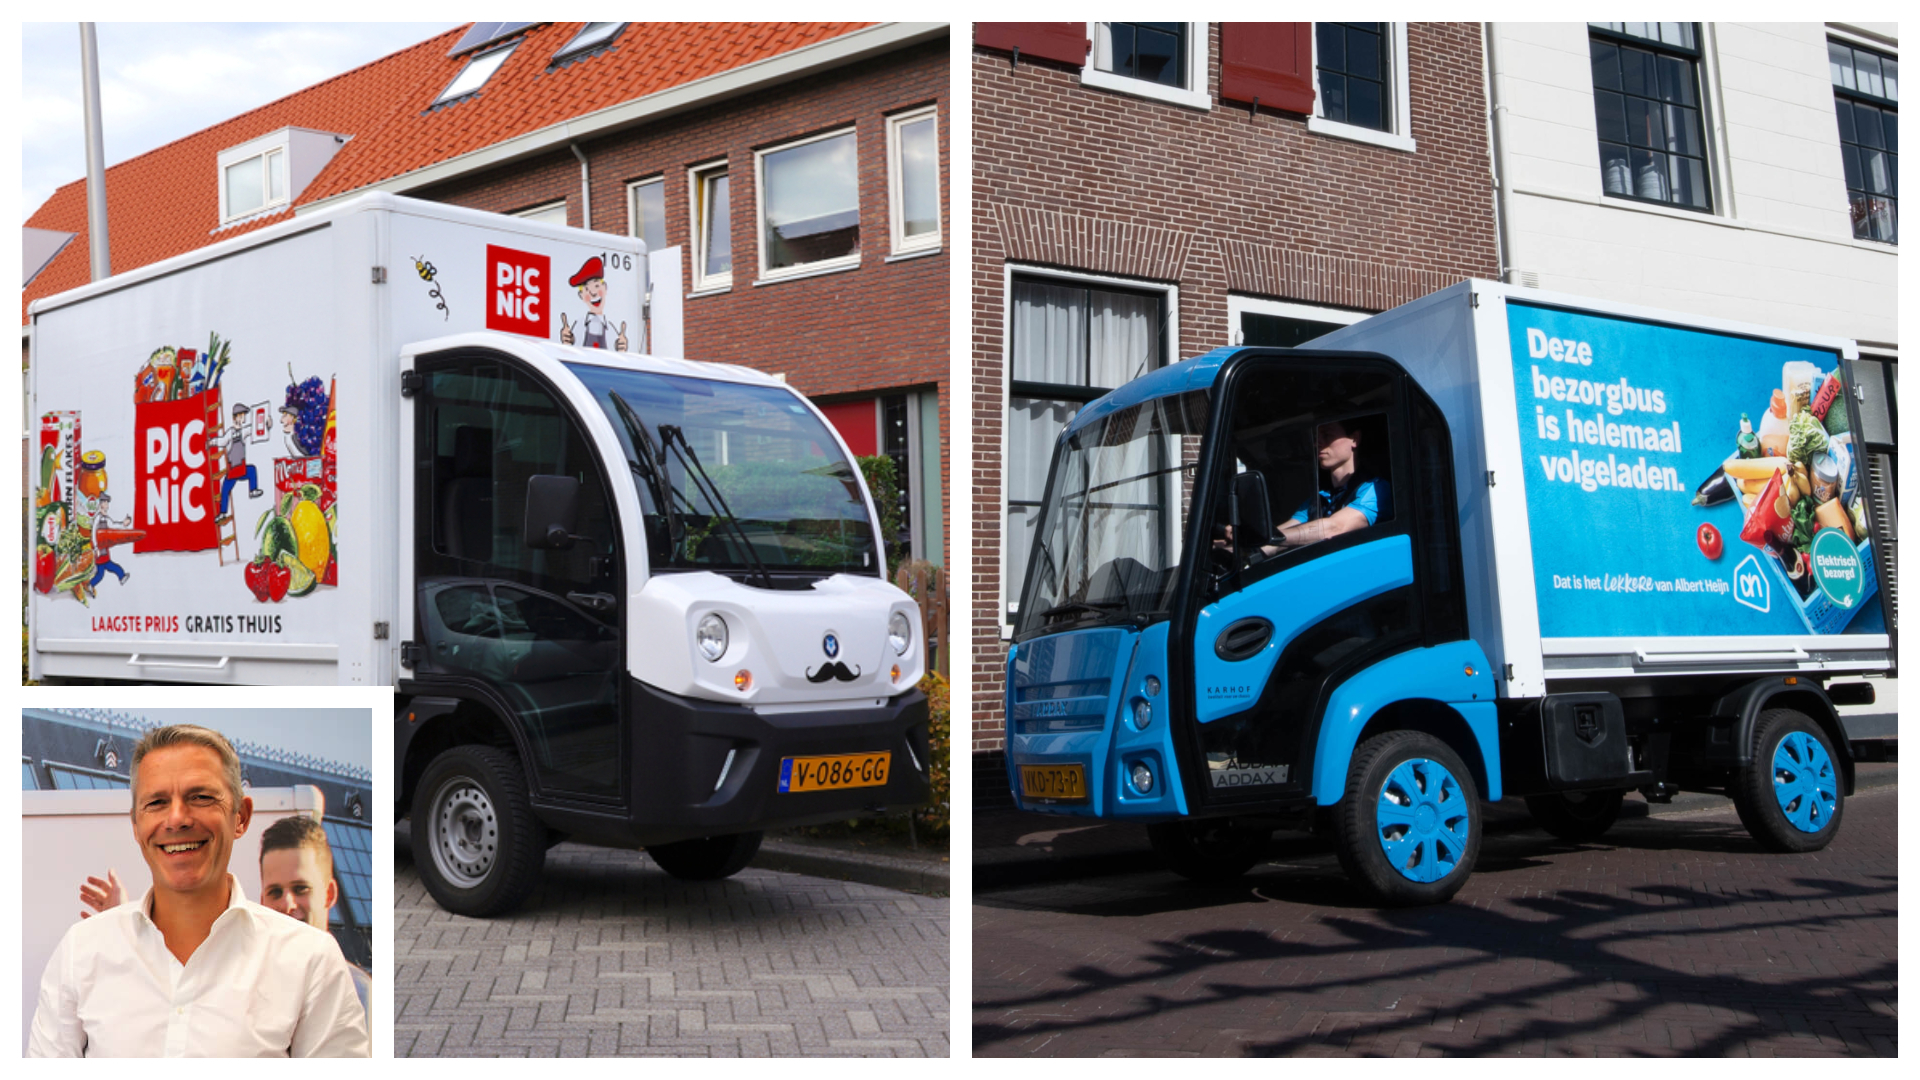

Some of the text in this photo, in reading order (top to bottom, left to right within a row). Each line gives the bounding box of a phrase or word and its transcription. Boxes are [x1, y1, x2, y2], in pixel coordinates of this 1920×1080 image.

[600, 252, 631, 271] 106
[1527, 327, 1592, 366] Deze
[1531, 364, 1666, 415] bezorgbus
[1536, 405, 1682, 453] is helemaal
[1539, 449, 1685, 492] volgeladen.
[1816, 555, 1857, 567] Elektrisch
[1823, 566, 1856, 581] bezorgd
[1553, 574, 1571, 589] Dat
[1573, 574, 1582, 589] is
[1584, 574, 1601, 590] het
[1655, 580, 1673, 591] van
[1675, 578, 1704, 592] Albert
[1706, 578, 1729, 595] Heijn
[92, 615, 282, 634] LAAGSTE PRIJS GRATIS THUIS
[1207, 686, 1251, 694] KARHOF
[798, 757, 885, 788] V-086-GG
[1024, 769, 1078, 794] VKD-73-P
[1216, 771, 1276, 787] ADDAX
